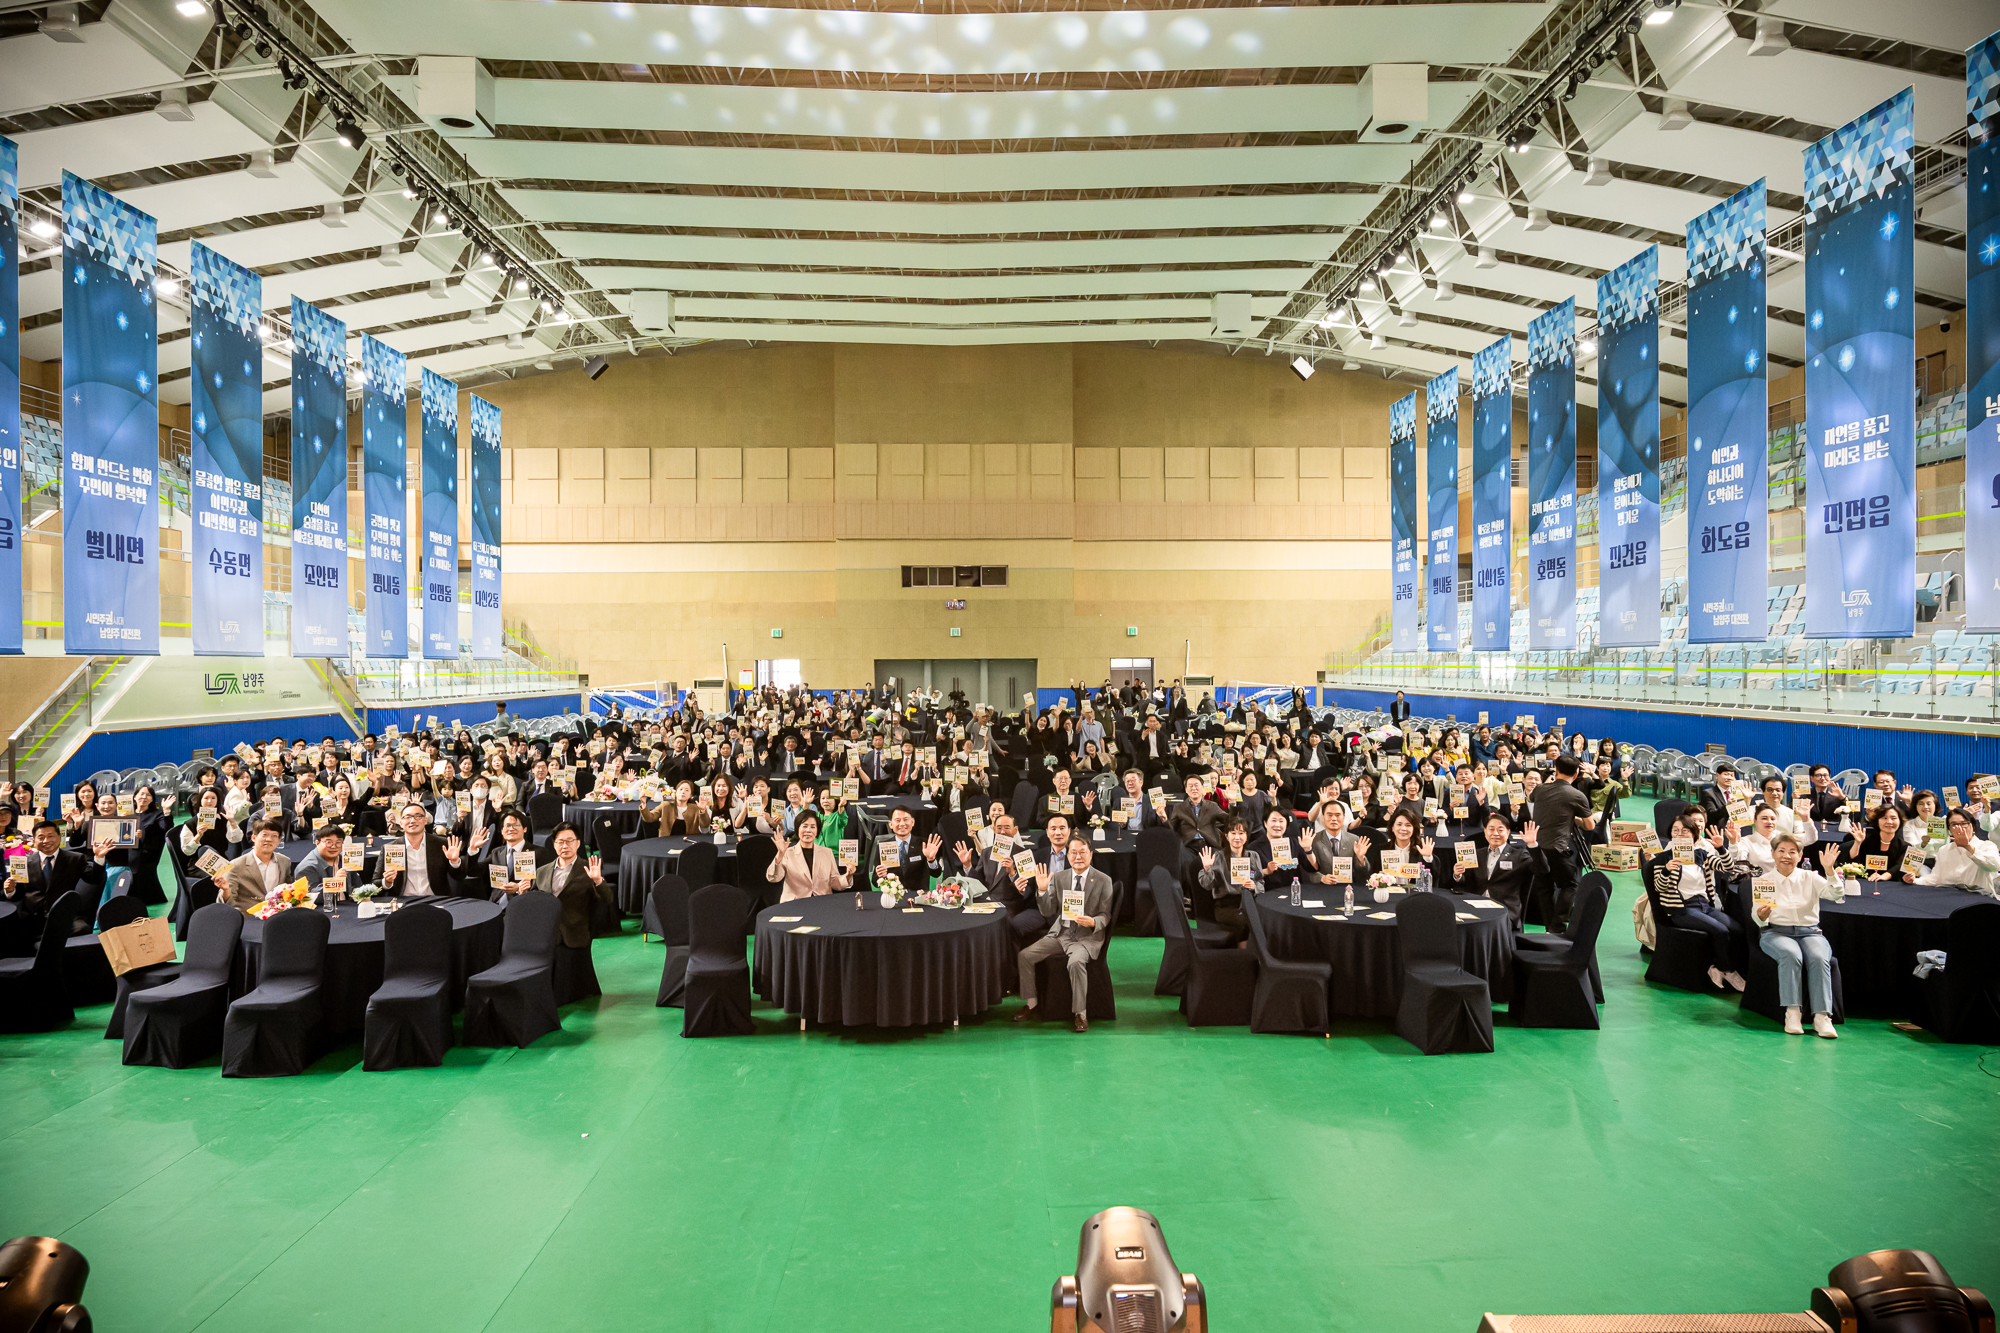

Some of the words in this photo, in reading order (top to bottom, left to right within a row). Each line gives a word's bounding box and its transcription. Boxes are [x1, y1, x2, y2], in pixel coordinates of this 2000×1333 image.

[1824, 421, 1860, 446] 자연을
[1863, 414, 1890, 438] 품고
[1711, 444, 1739, 465] 시민과
[1824, 445, 1860, 469] 미래로
[1863, 440, 1889, 462] 뻗는
[71, 452, 94, 474] 함께
[97, 458, 130, 482] 만드는
[132, 467, 152, 486] 변화
[1707, 463, 1744, 486] 하나되어
[79, 476, 112, 498] 주민이
[115, 482, 146, 504] 행복한
[225, 477, 241, 496] 맑은
[1708, 484, 1743, 506] 도약하는
[211, 493, 247, 516] 시민주권
[1614, 491, 1641, 510] 묻어나는
[1543, 512, 1559, 528] 모두가
[1618, 509, 1638, 526] 정겨운
[1823, 494, 1890, 534] 진접읍
[240, 519, 257, 536] 중심
[294, 529, 313, 545] 새로운
[1701, 521, 1750, 554] 화도읍
[86, 530, 144, 564] 별내면
[1610, 541, 1646, 569] 진건읍
[209, 547, 250, 578] 수동면
[1537, 556, 1566, 580] 호평동
[304, 564, 338, 588] 조안면
[373, 574, 400, 595] 평내동
[1433, 576, 1451, 595] 별내동
[1478, 567, 1505, 588] 다산1동
[1396, 583, 1412, 600] 금곡동
[1713, 614, 1730, 626] 남양주
[1731, 614, 1749, 625] 대전환
[1848, 608, 1864, 618] 남양주
[100, 627, 120, 640] 남양주
[121, 628, 141, 640] 대전환
[243, 673, 264, 687] 남양주
